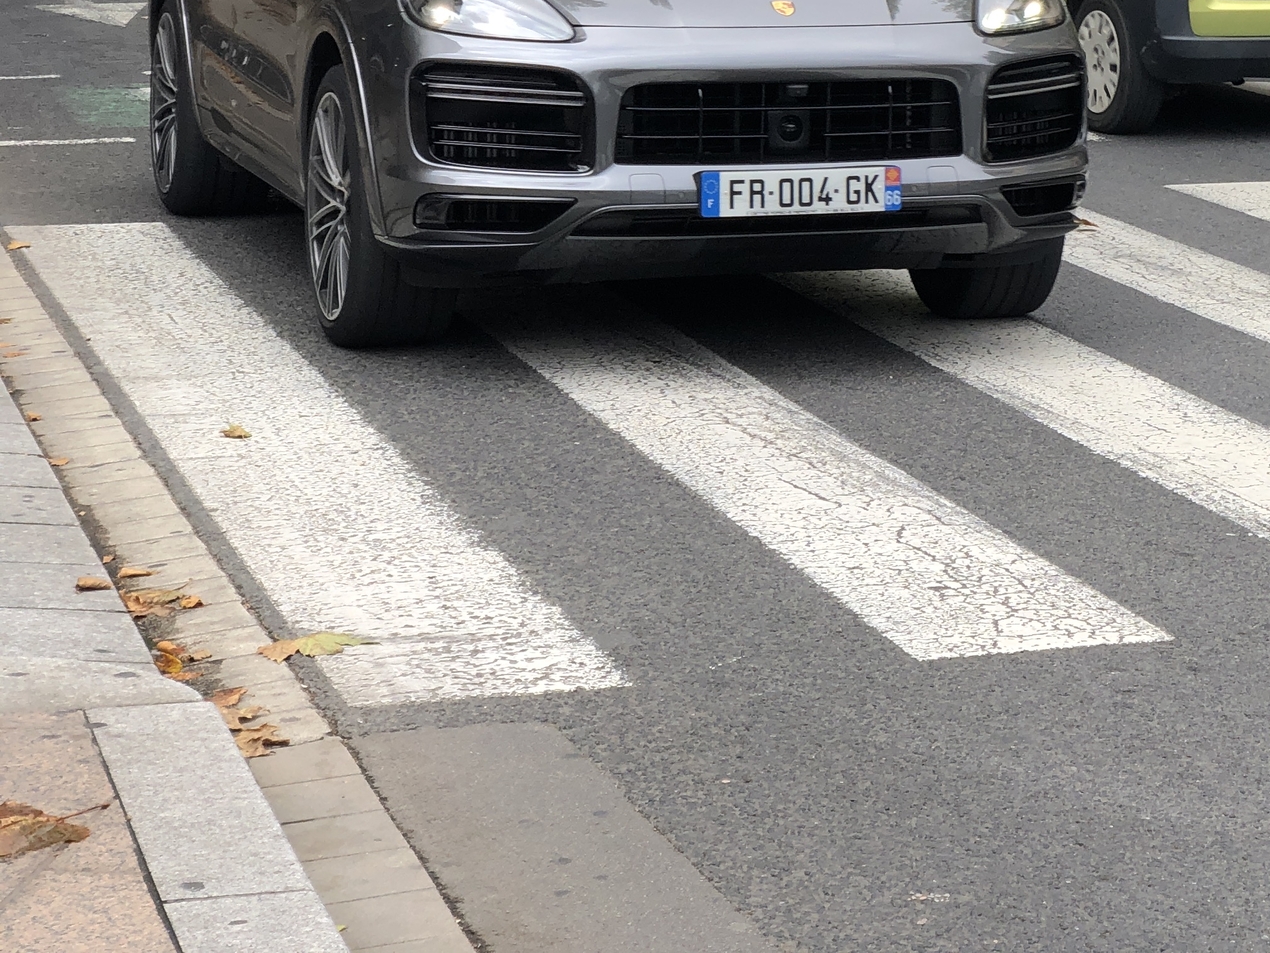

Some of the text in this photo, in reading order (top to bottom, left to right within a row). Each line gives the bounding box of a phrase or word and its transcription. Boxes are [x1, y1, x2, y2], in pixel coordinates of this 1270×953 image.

[707, 174, 901, 210] F FR-004-GK 66
